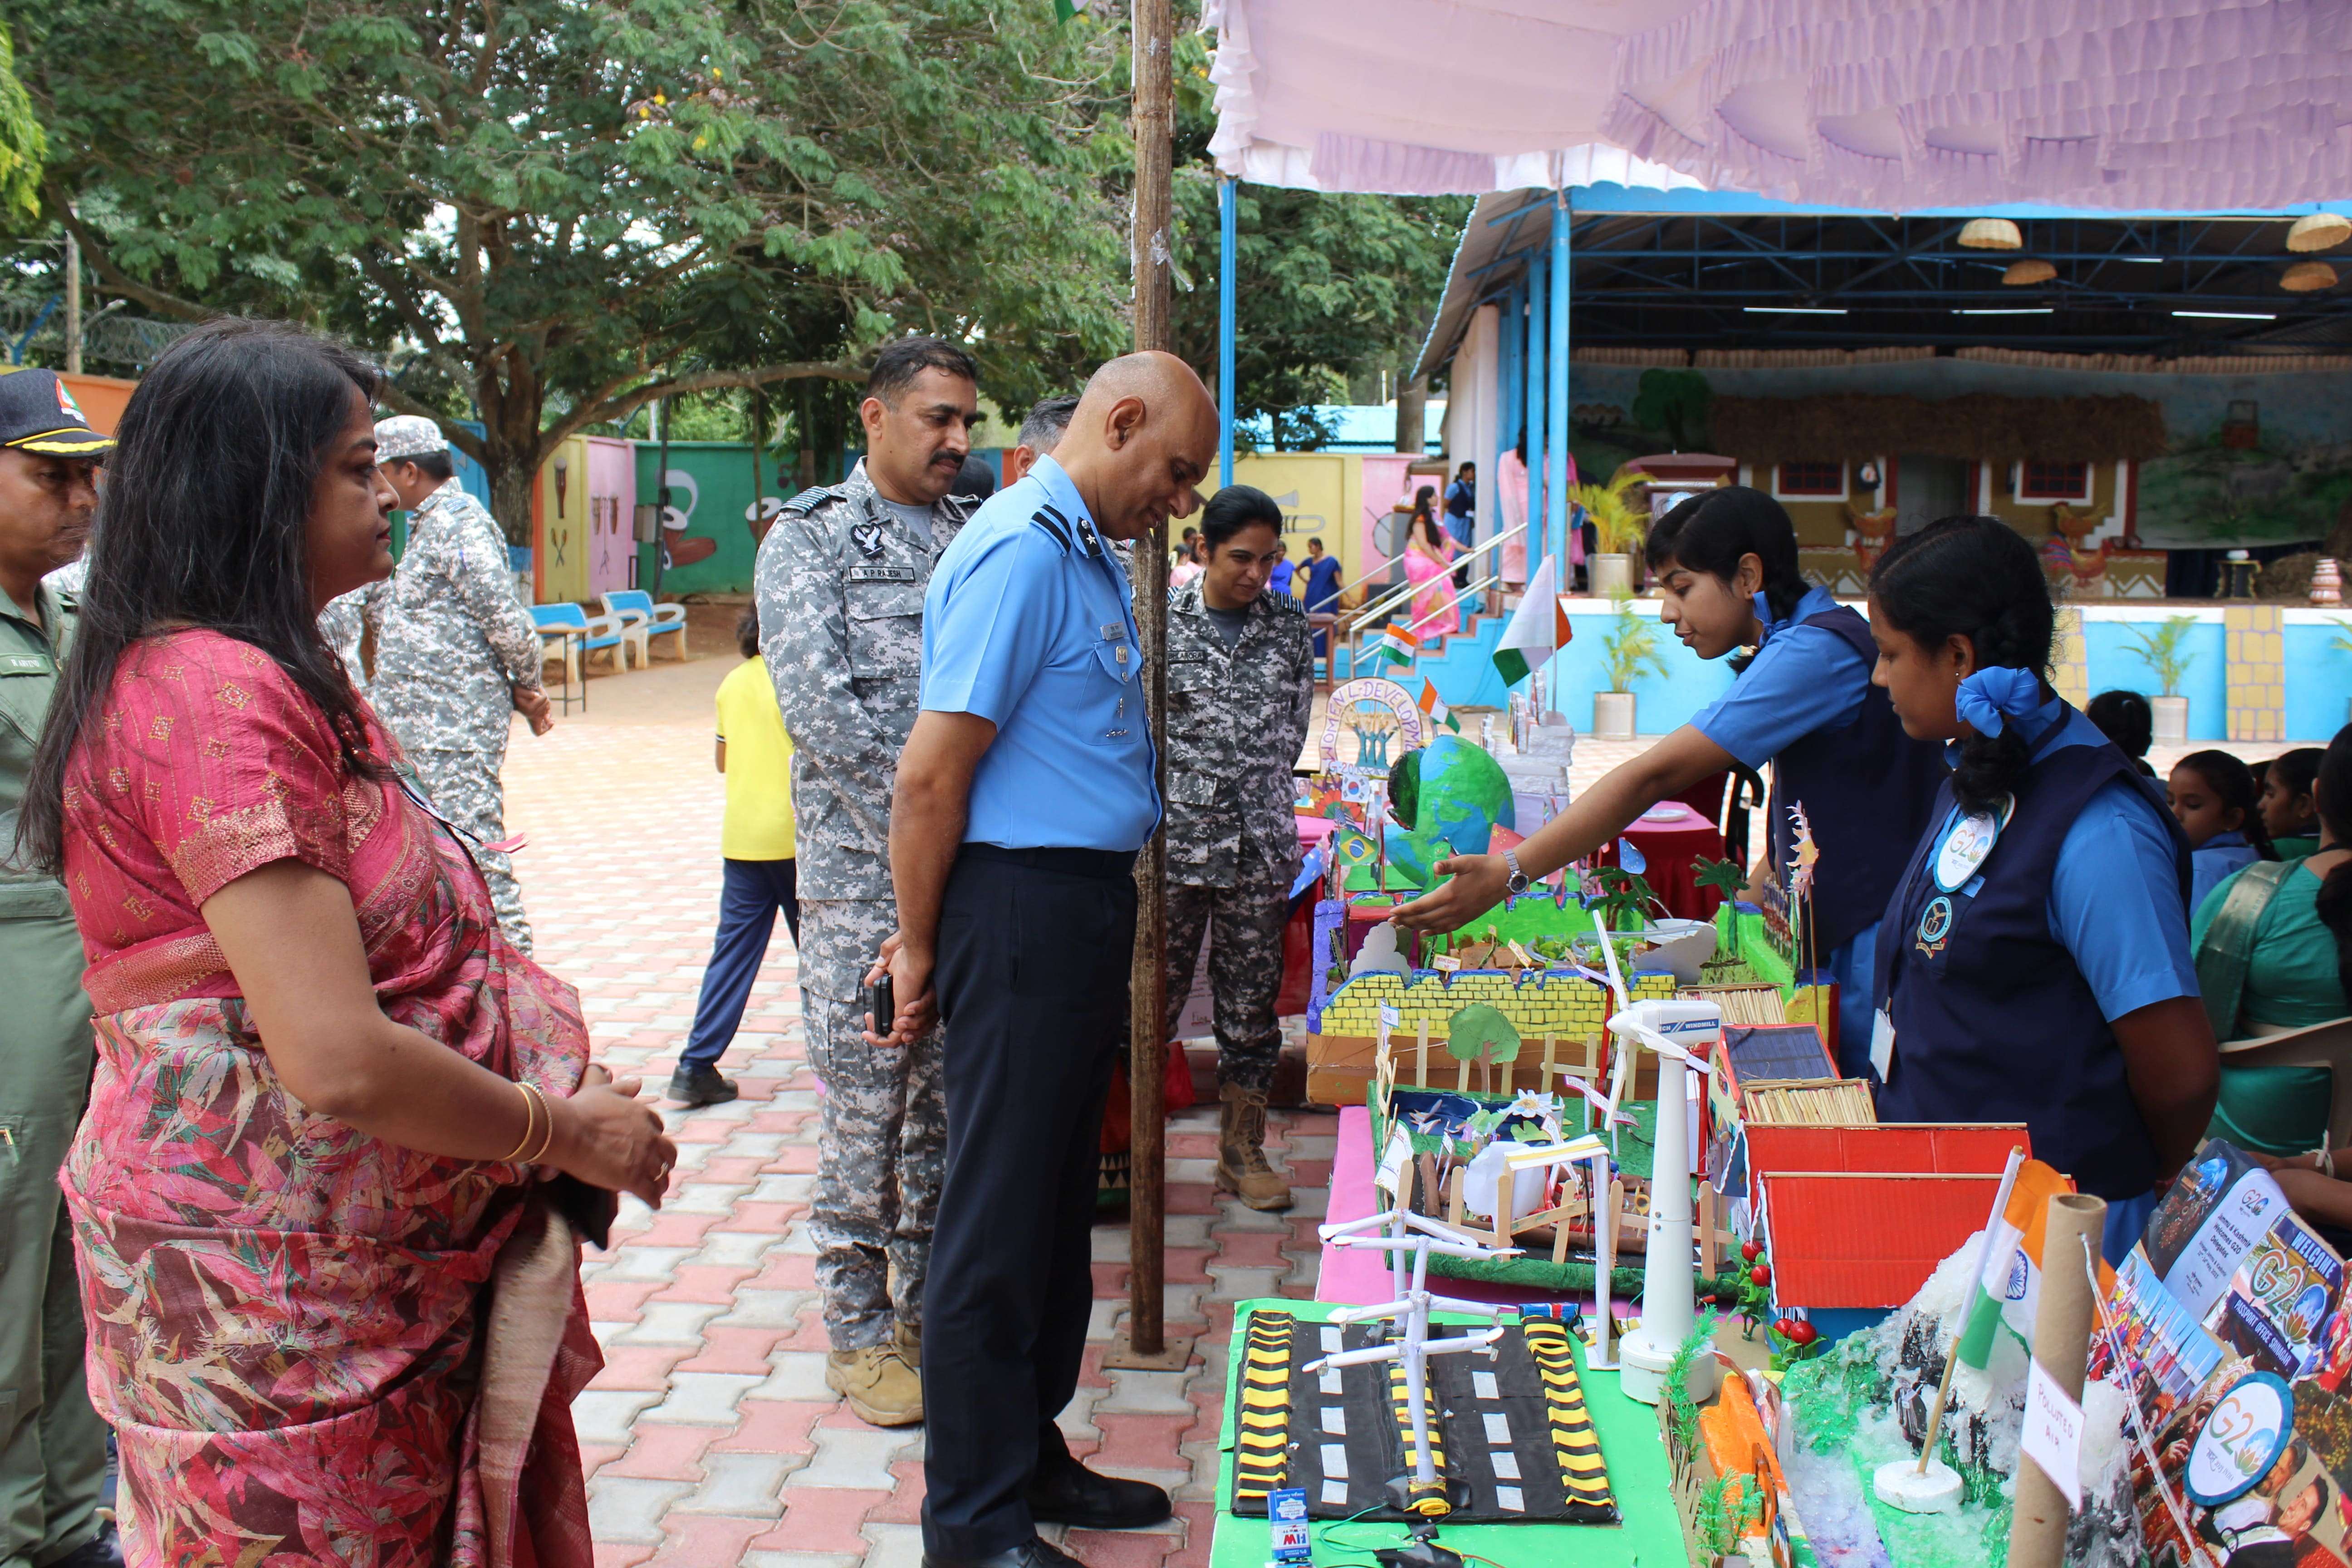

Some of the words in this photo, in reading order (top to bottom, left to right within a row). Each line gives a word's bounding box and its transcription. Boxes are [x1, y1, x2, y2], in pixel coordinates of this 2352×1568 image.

[877, 570, 902, 578] RAJESH
[1321, 691, 1344, 761] WOMEN
[1950, 829, 1989, 864] G20
[1685, 1021, 1716, 1029] WINDMILL
[2242, 1189, 2269, 1216] G20
[2210, 1235, 2229, 1259] Delegates
[2214, 1222, 2232, 1245] Welcomes
[2230, 1241, 2242, 1254] G20
[2217, 1212, 2231, 1228] Jammu
[2232, 1226, 2251, 1249] Kashmir
[2291, 1231, 2337, 1279] WELCOME
[2250, 1249, 2328, 1344] G20
[2234, 1299, 2259, 1328] PASSPORT
[2254, 1320, 2273, 1343] OFFICE
[2269, 1337, 2291, 1367] SRINAGAR
[2038, 1383, 2073, 1439] POLLUTED
[2045, 1424, 2061, 1452] AIR
[2209, 1396, 2276, 1477] G20
[2222, 1466, 2234, 1482] INDIA
